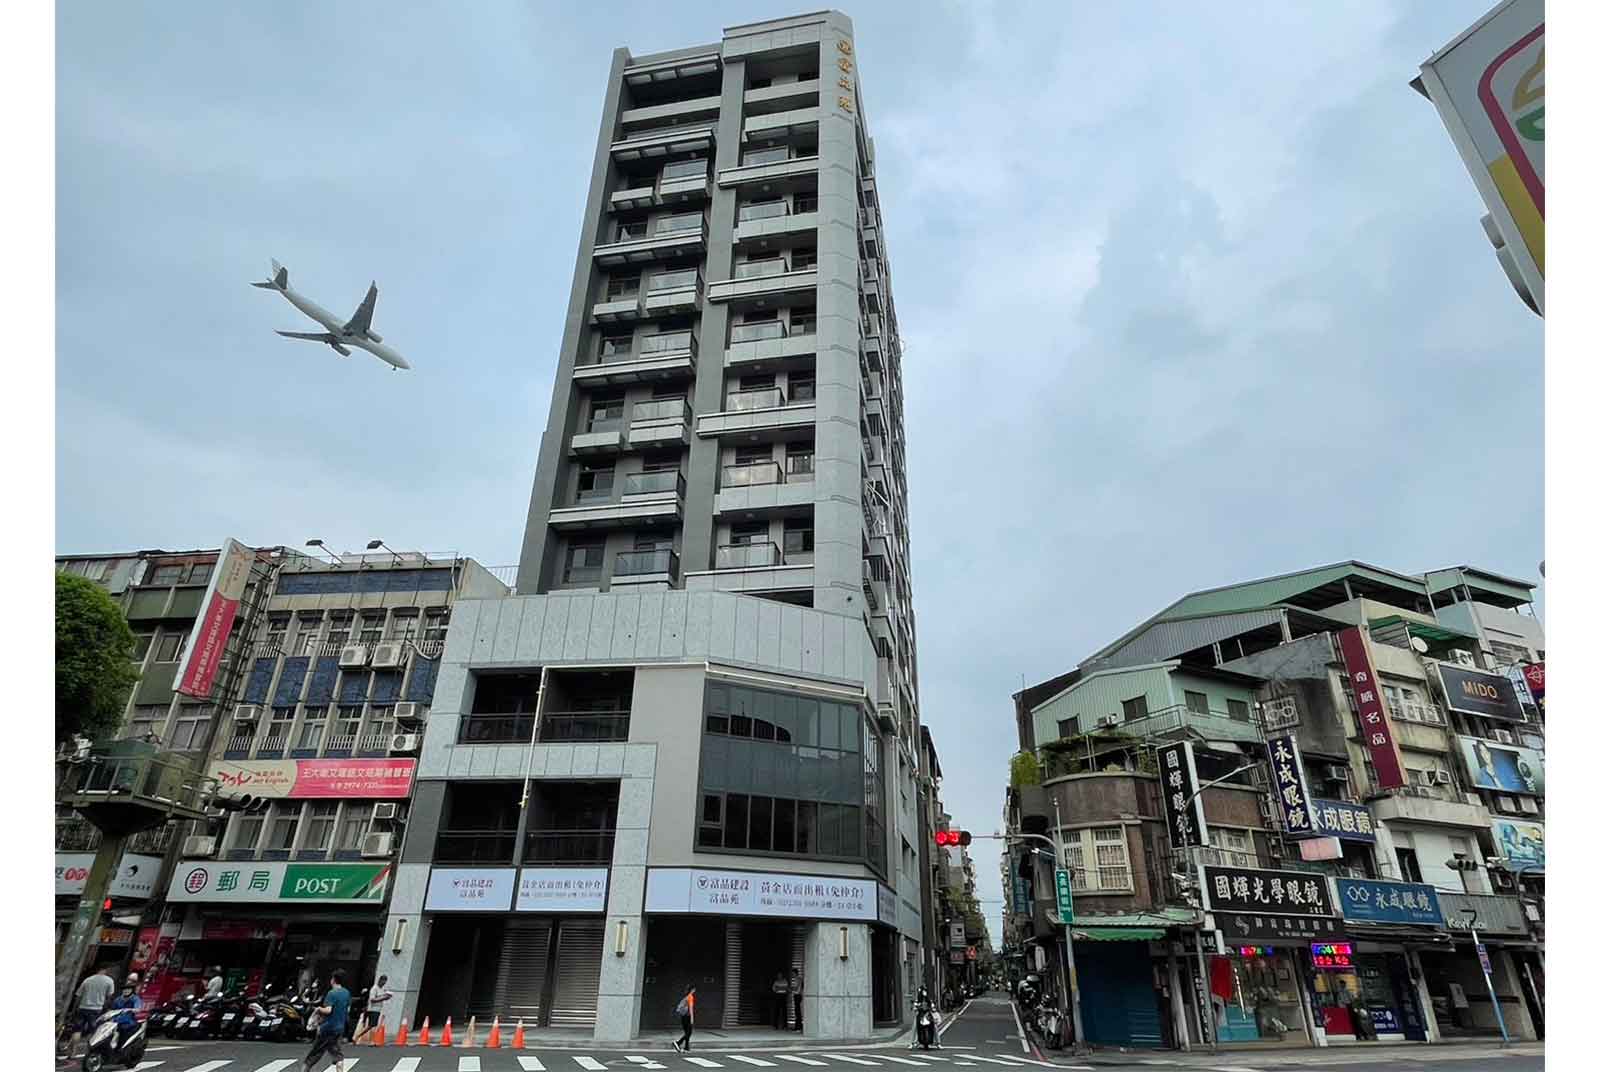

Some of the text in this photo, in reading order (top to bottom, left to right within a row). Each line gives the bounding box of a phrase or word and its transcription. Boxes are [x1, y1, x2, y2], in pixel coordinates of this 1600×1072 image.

[1462, 680, 1498, 699] MIDO
[1274, 740, 1309, 828] 永成眼鏡
[216, 870, 271, 892] 郵局
[295, 878, 340, 894] POST
[1375, 886, 1433, 912] 永成眼鏡
